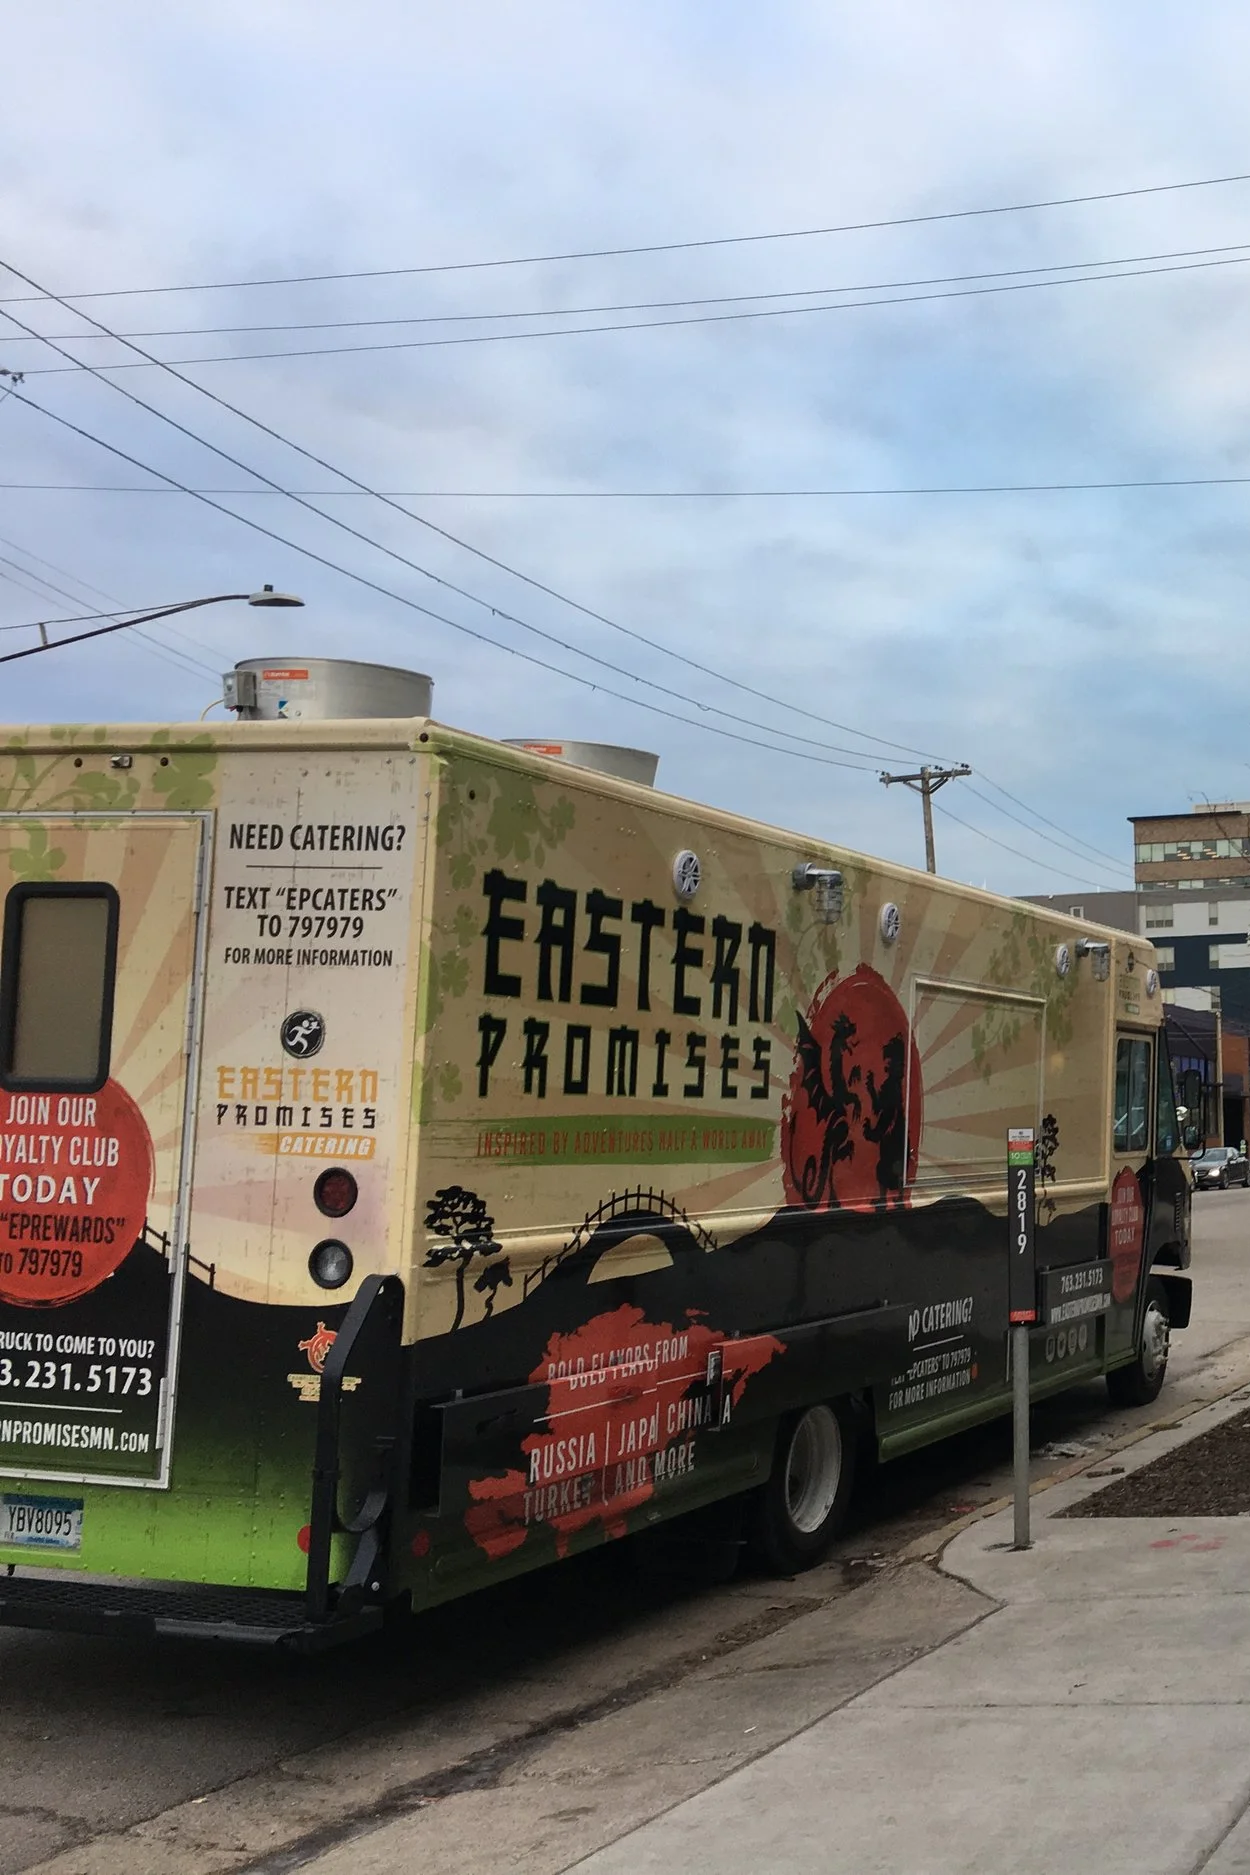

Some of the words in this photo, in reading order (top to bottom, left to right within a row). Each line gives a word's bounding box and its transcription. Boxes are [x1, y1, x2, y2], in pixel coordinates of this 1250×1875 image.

[229, 824, 284, 850] NEED
[290, 825, 406, 851] CATERING?
[224, 886, 271, 909] TEXT
[275, 887, 398, 911] "EPCATERS"
[257, 915, 282, 937] TO
[288, 916, 364, 938] 797979
[224, 948, 250, 964] FOR
[253, 949, 293, 965] MORE
[296, 950, 393, 966] INFORMATION
[482, 868, 776, 1026] EASTERN
[477, 1012, 771, 1099] PROMISES
[217, 1066, 378, 1104] EASTERN
[6, 1096, 50, 1125] JOIN
[58, 1098, 96, 1127] OUR
[217, 1103, 376, 1129] PROMISES
[0, 1133, 63, 1165] YALTY
[69, 1136, 119, 1167] CLUB
[279, 1135, 371, 1155] CATERING
[477, 1131, 546, 1157] INSPIRED
[553, 1131, 568, 1155] BY
[574, 1129, 654, 1155] ADVENTURES
[659, 1129, 687, 1151] HALF
[691, 1130, 698, 1150] A
[703, 1128, 737, 1150] WORLD
[741, 1128, 768, 1150] AWAY
[0, 1174, 100, 1205] TODAY
[1016, 1169, 1028, 1254] 2819
[18, 1248, 82, 1277] 797979
[1061, 1267, 1104, 1294] 763.231.5173
[922, 1296, 973, 1333] CATERING?
[0, 1331, 33, 1351] RUCK
[35, 1333, 53, 1353] TO
[56, 1335, 95, 1354] COME
[98, 1337, 116, 1356] TO
[119, 1338, 155, 1358] YOU?
[655, 1335, 689, 1367] FROM
[0, 1358, 152, 1396] 3.231.5173
[889, 1390, 904, 1411] FOR
[904, 1383, 925, 1405] MORE
[926, 1368, 971, 1398] INFORMATION
[0, 1419, 149, 1453] NPROMISESMN.COM
[530, 1432, 596, 1483] RUSSIA
[523, 1472, 596, 1526] TURKE
[654, 1441, 696, 1481] MORE
[9, 1506, 72, 1536] YBV8095
